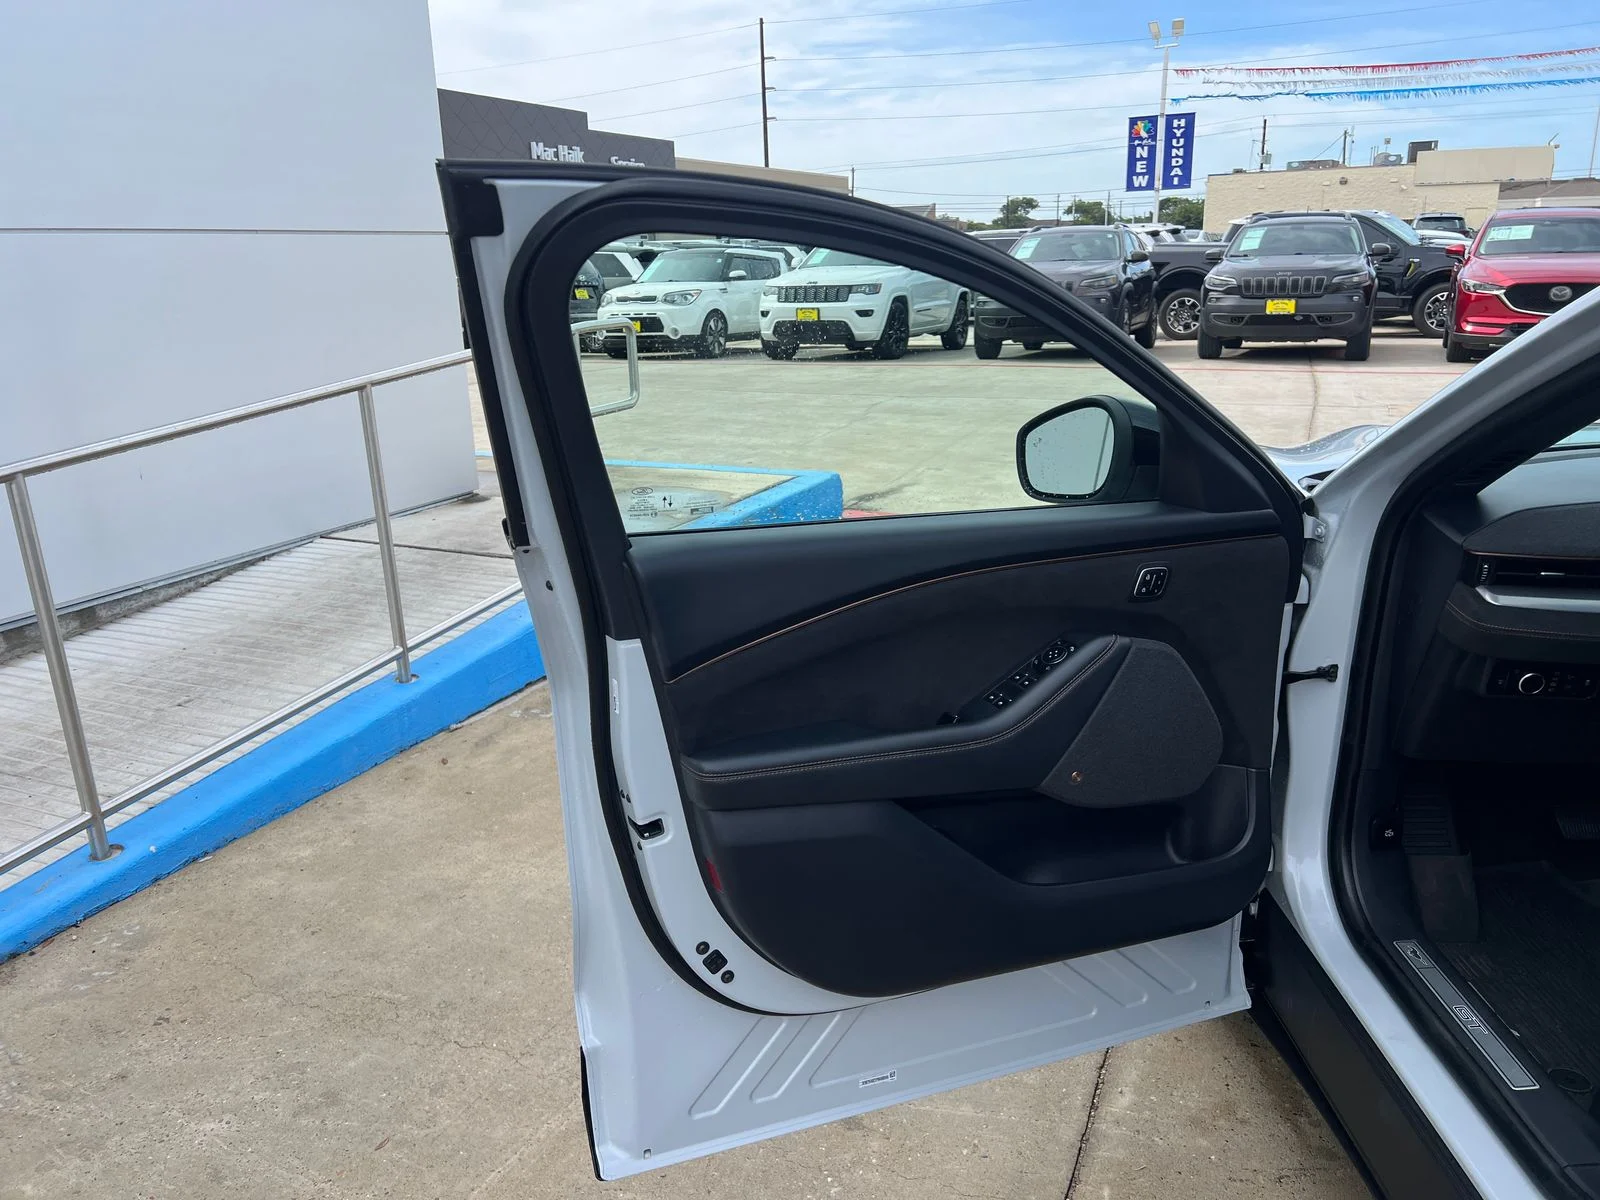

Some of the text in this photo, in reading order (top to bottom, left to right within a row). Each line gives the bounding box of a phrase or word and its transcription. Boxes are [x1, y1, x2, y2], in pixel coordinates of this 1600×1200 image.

[530, 141, 585, 163] Mac Haik
[1132, 146, 1149, 187] NEW
[1170, 118, 1186, 185] HYUNDAI
[1453, 1005, 1488, 1034] GT
